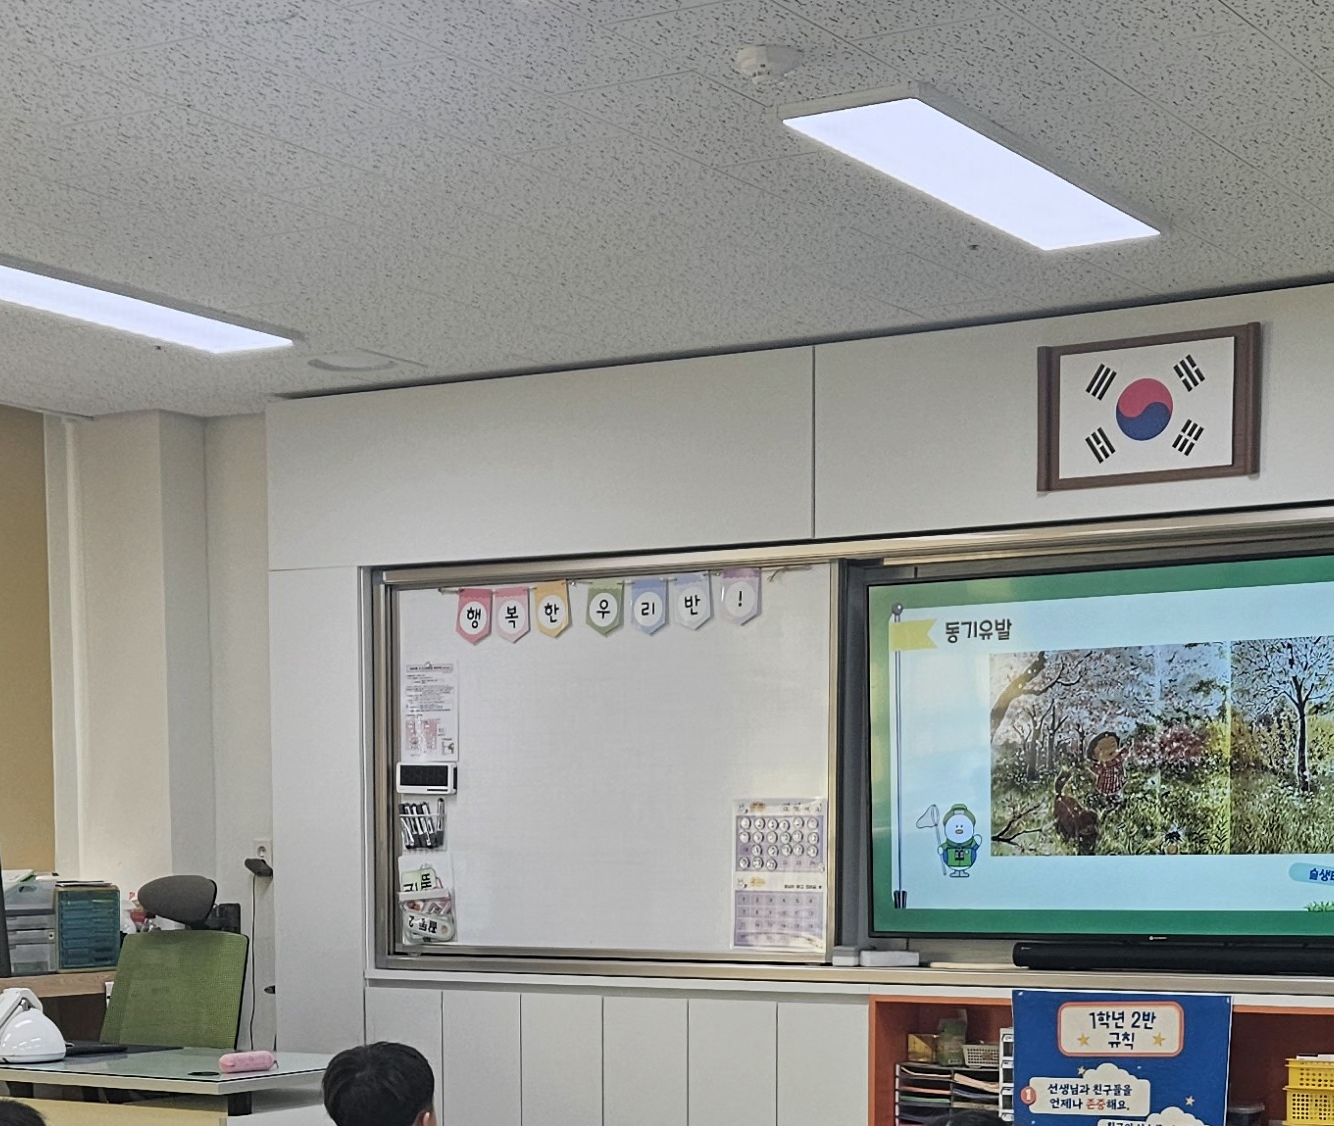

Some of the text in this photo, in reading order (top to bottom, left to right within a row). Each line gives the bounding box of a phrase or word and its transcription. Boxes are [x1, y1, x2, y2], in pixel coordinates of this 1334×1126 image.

[946, 619, 1012, 643] 동기유발
[1089, 1011, 1156, 1029] 1학년 2반
[1108, 1031, 1135, 1050] 규칙
[1048, 1083, 1132, 1096] 선생님과 친구들을
[1050, 1098, 1129, 1110] 언제나 존중해요.
